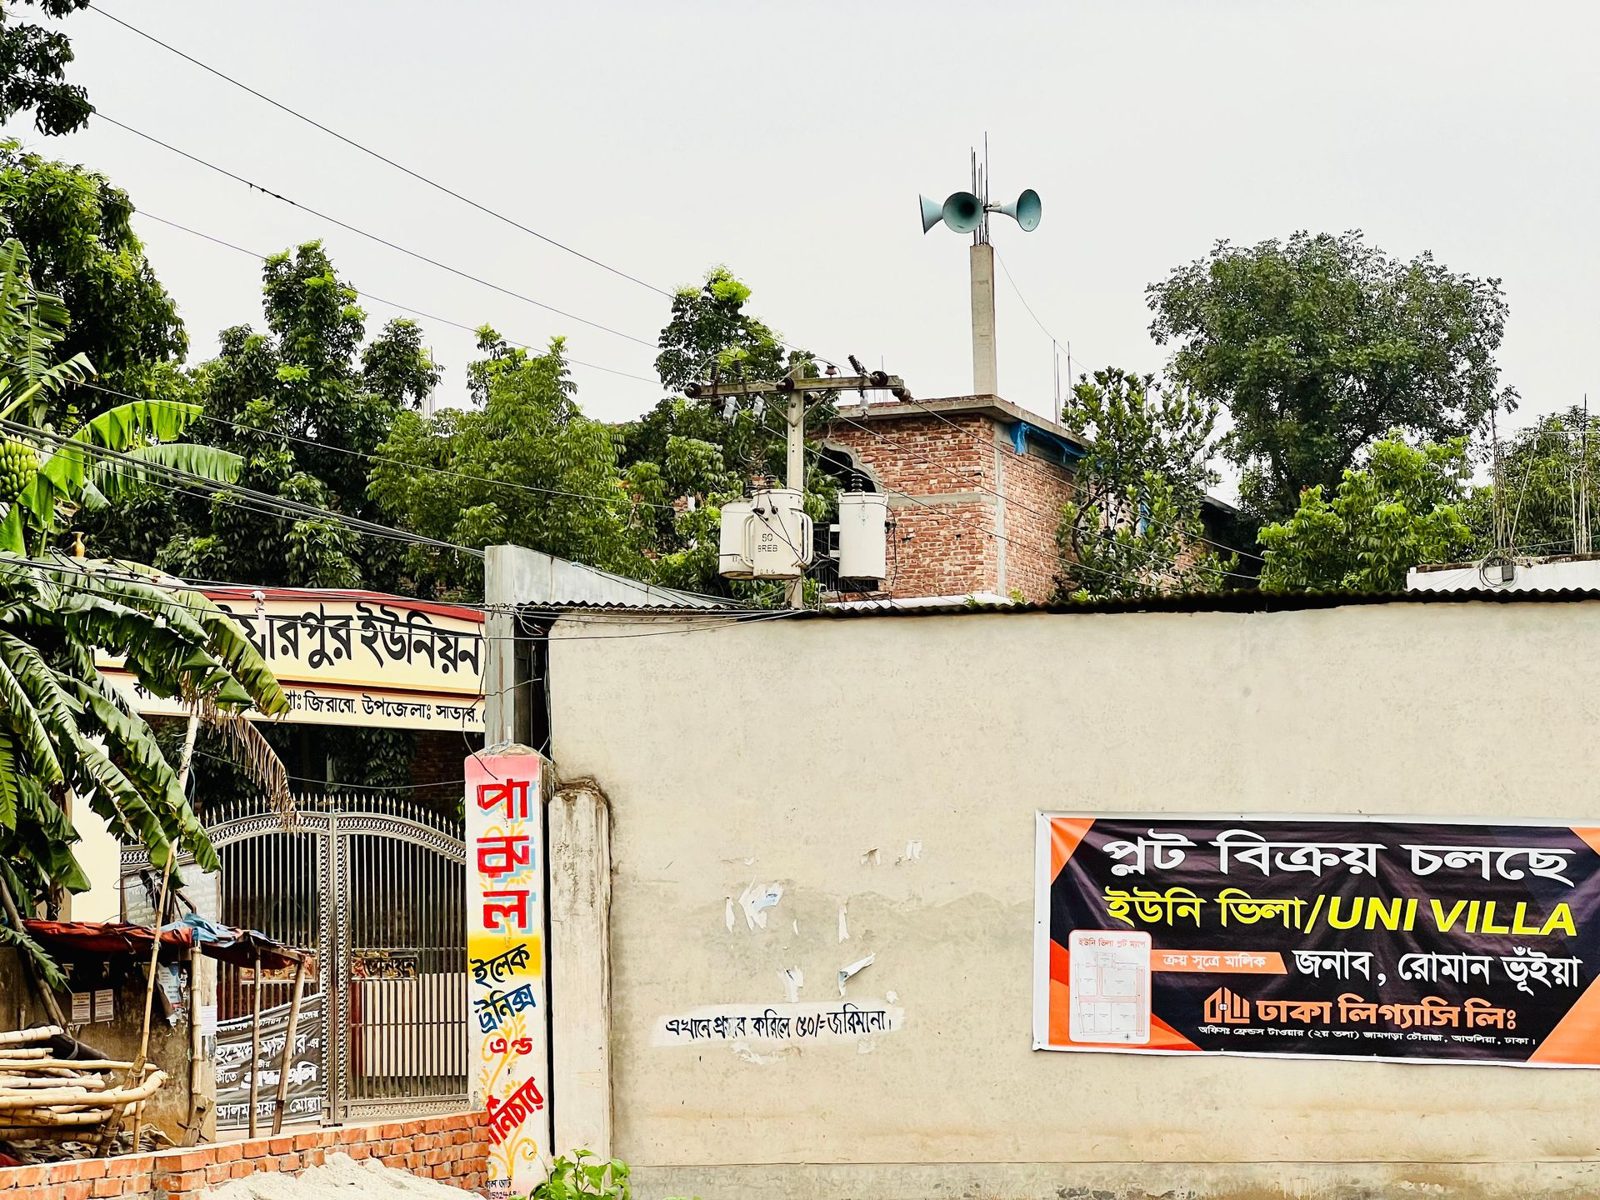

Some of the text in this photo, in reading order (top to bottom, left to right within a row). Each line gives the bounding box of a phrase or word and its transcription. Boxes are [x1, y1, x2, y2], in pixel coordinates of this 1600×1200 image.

[355, 601, 483, 676] ইউনিয়ন
[361, 692, 431, 720] উপজেলাঃ
[1102, 828, 1577, 888] প্লট বিক্রয় চলছে
[1102, 886, 1207, 928] ইউনি
[1430, 899, 1578, 937] VILLA
[470, 943, 530, 988] ইলেক
[1163, 952, 1267, 971] ক্রয় সূত্রে মালিক
[1398, 952, 1494, 985] রোমান
[1500, 947, 1583, 996] ভূঁইয়া
[666, 1018, 712, 1039] এখানে
[751, 1008, 791, 1039] করিলে
[1256, 993, 1516, 1030] ঢাকা লিগ্যাসি লিঃ
